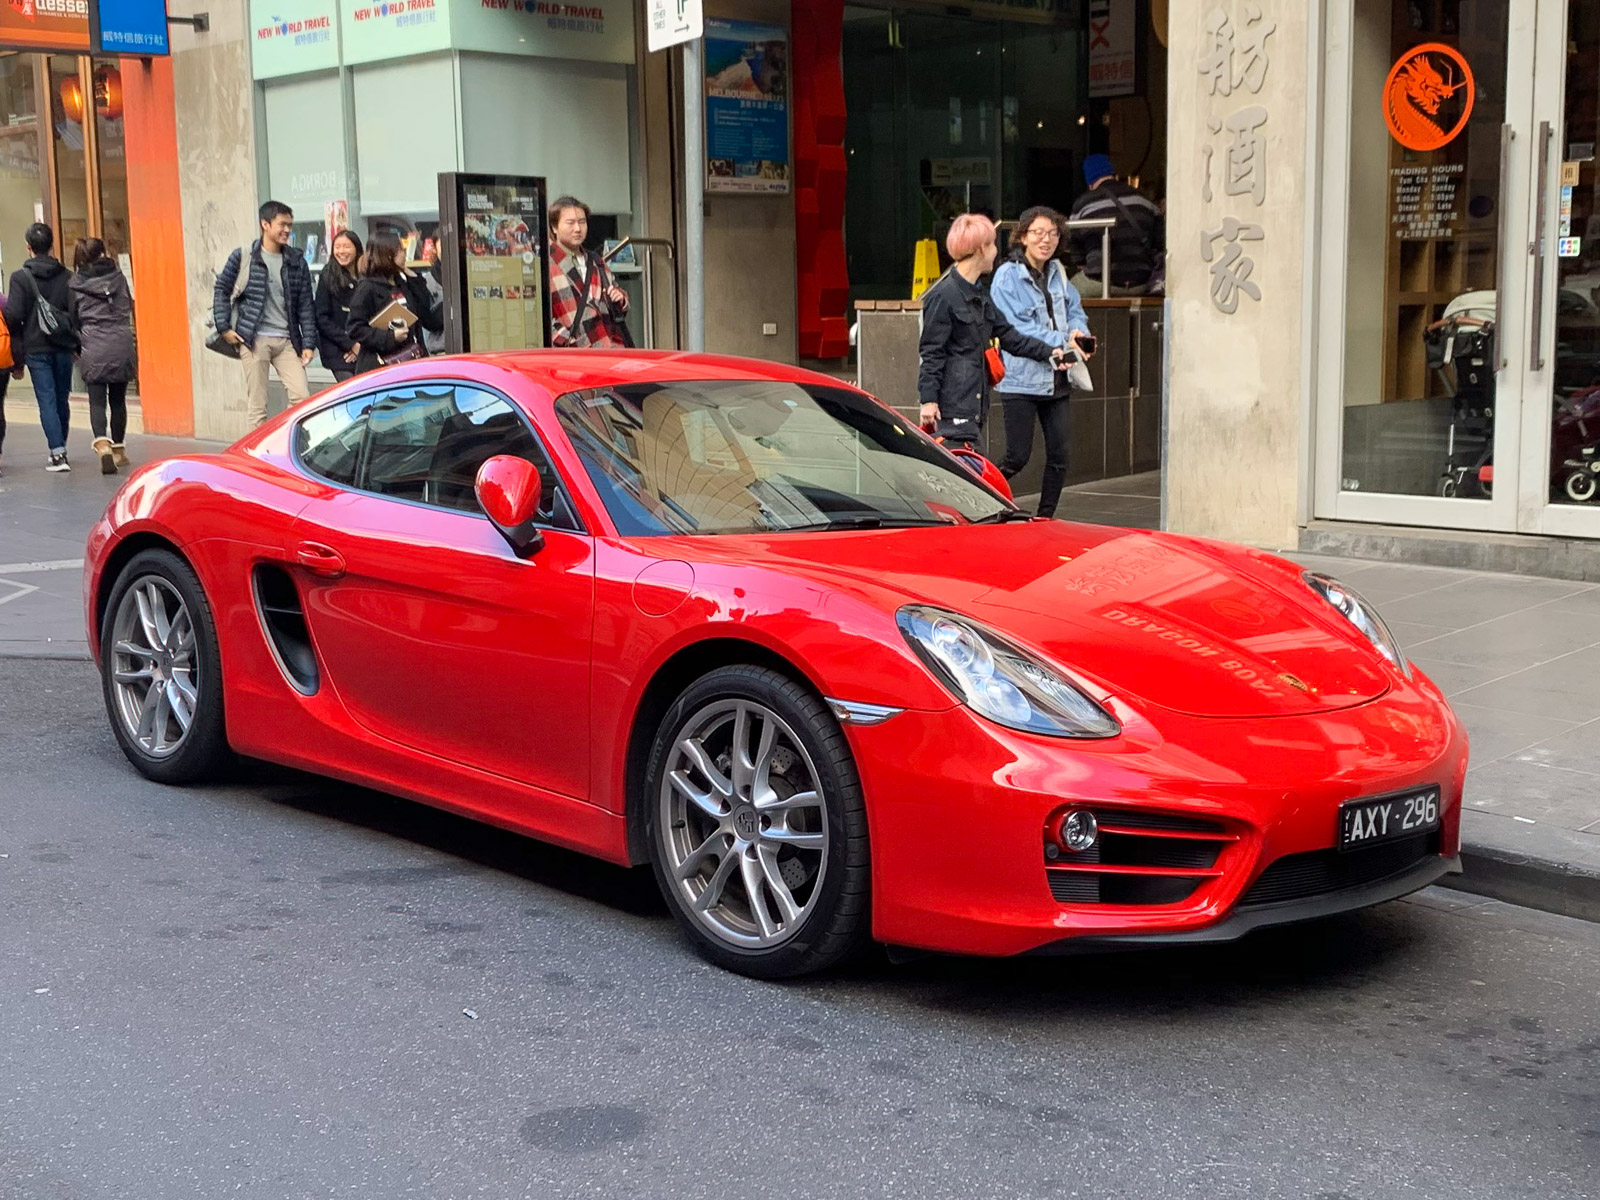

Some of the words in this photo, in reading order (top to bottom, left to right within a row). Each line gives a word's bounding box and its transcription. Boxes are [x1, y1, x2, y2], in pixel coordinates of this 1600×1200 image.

[35, 0, 89, 13] desse
[354, 8, 371, 21] NEW
[374, 2, 404, 18] WORLD
[407, 0, 436, 13] TRAVEL
[481, 0, 508, 9] NEW
[514, 0, 560, 15] WORLD
[563, 5, 605, 20] TRAVEL
[653, 9, 666, 21] OTHER
[257, 27, 273, 40] NEW
[275, 21, 302, 36] WORLD
[304, 16, 330, 31] TRAVEL
[654, 20, 665, 31] TIMES
[1390, 167, 1427, 176] TRADING
[1432, 164, 1464, 173] HOURS
[1432, 175, 1450, 183] Daily
[1396, 186, 1421, 194] Monday
[1432, 184, 1456, 193] Sunday
[1398, 204, 1420, 212] Dinner
[1437, 202, 1452, 210] Late
